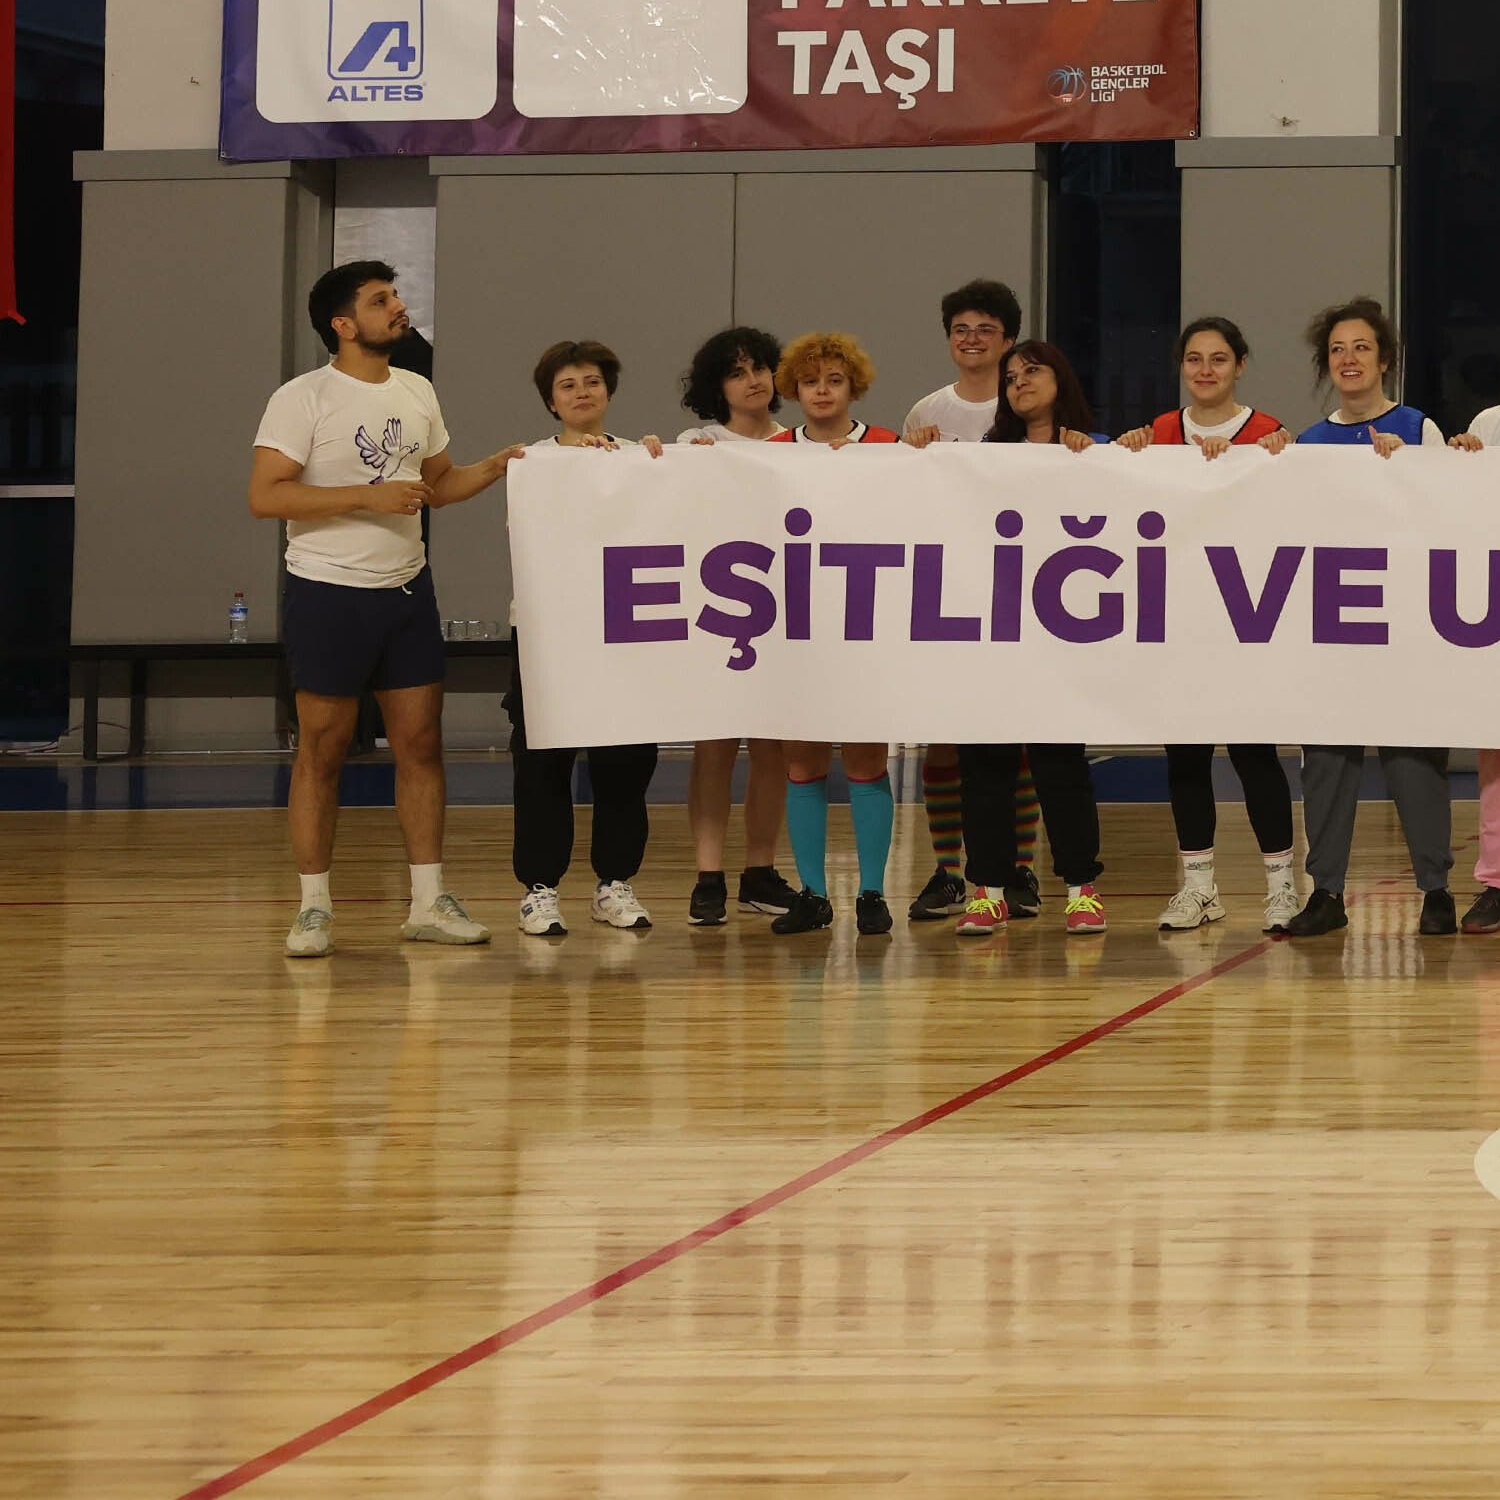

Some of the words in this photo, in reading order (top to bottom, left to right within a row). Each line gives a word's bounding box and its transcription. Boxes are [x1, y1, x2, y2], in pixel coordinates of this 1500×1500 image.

[777, 28, 955, 109] TAŞI
[1091, 64, 1167, 77] BASKETBOL
[327, 84, 424, 102] ALTES
[1091, 78, 1149, 92] GENÇLER
[1091, 89, 1115, 102] LİGİ
[602, 507, 1166, 672] EŞİTLİĞİ
[1206, 545, 1389, 646] VE
